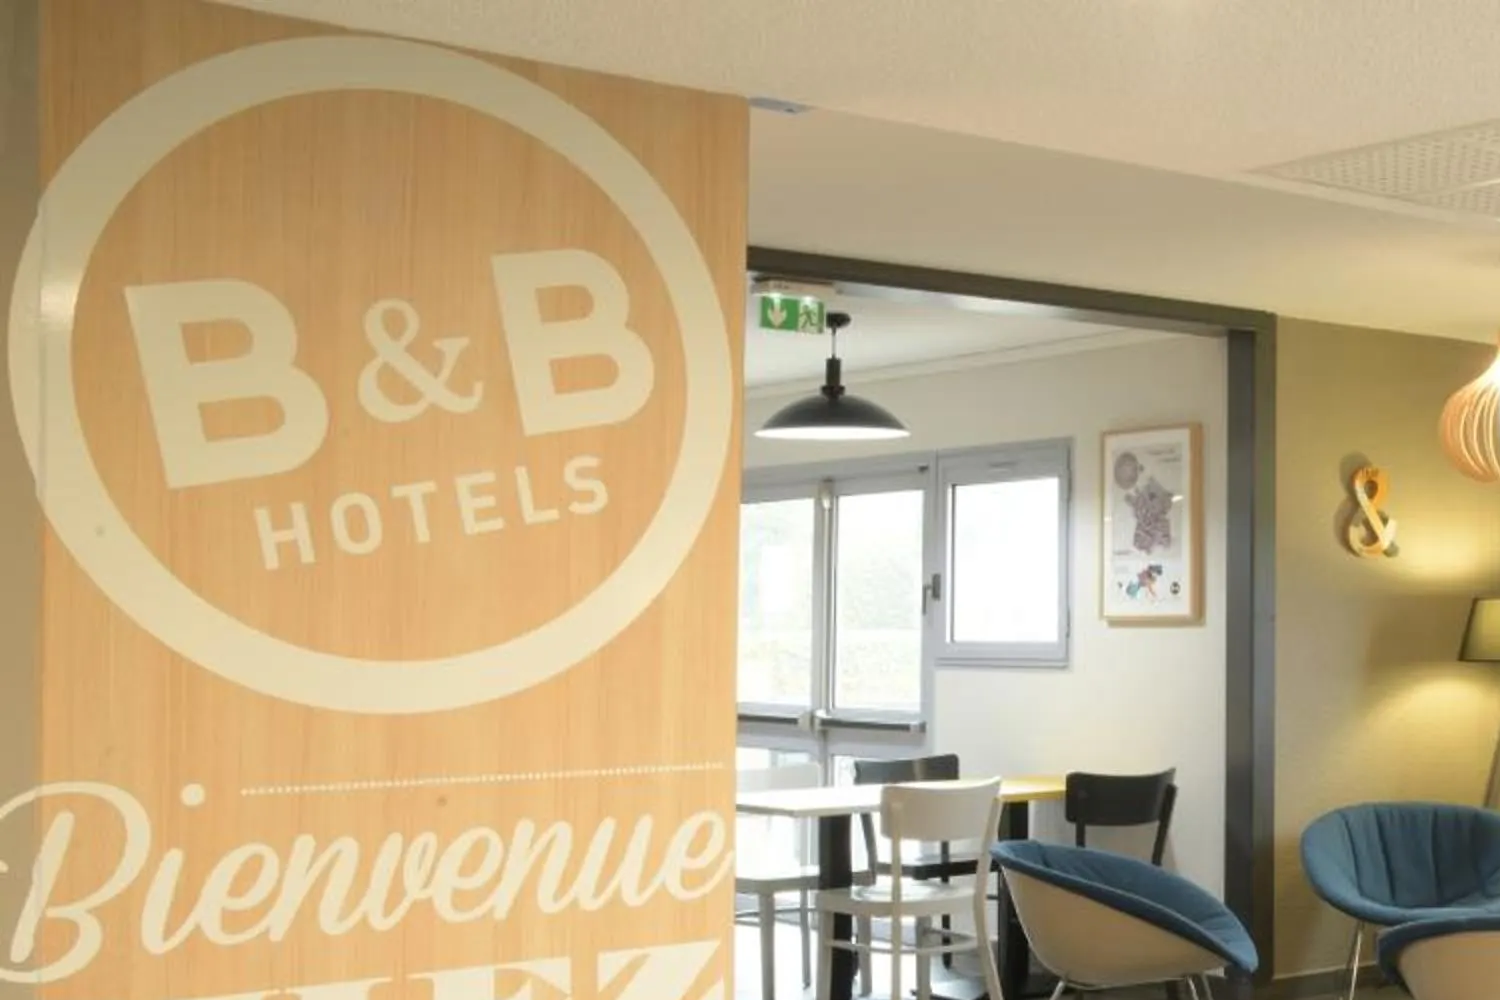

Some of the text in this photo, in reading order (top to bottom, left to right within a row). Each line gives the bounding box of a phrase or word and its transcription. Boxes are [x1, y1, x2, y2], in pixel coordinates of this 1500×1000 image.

[124, 248, 655, 490] B&B
[254, 455, 610, 571] HOTELS
[0, 781, 734, 984] Bienvenue
